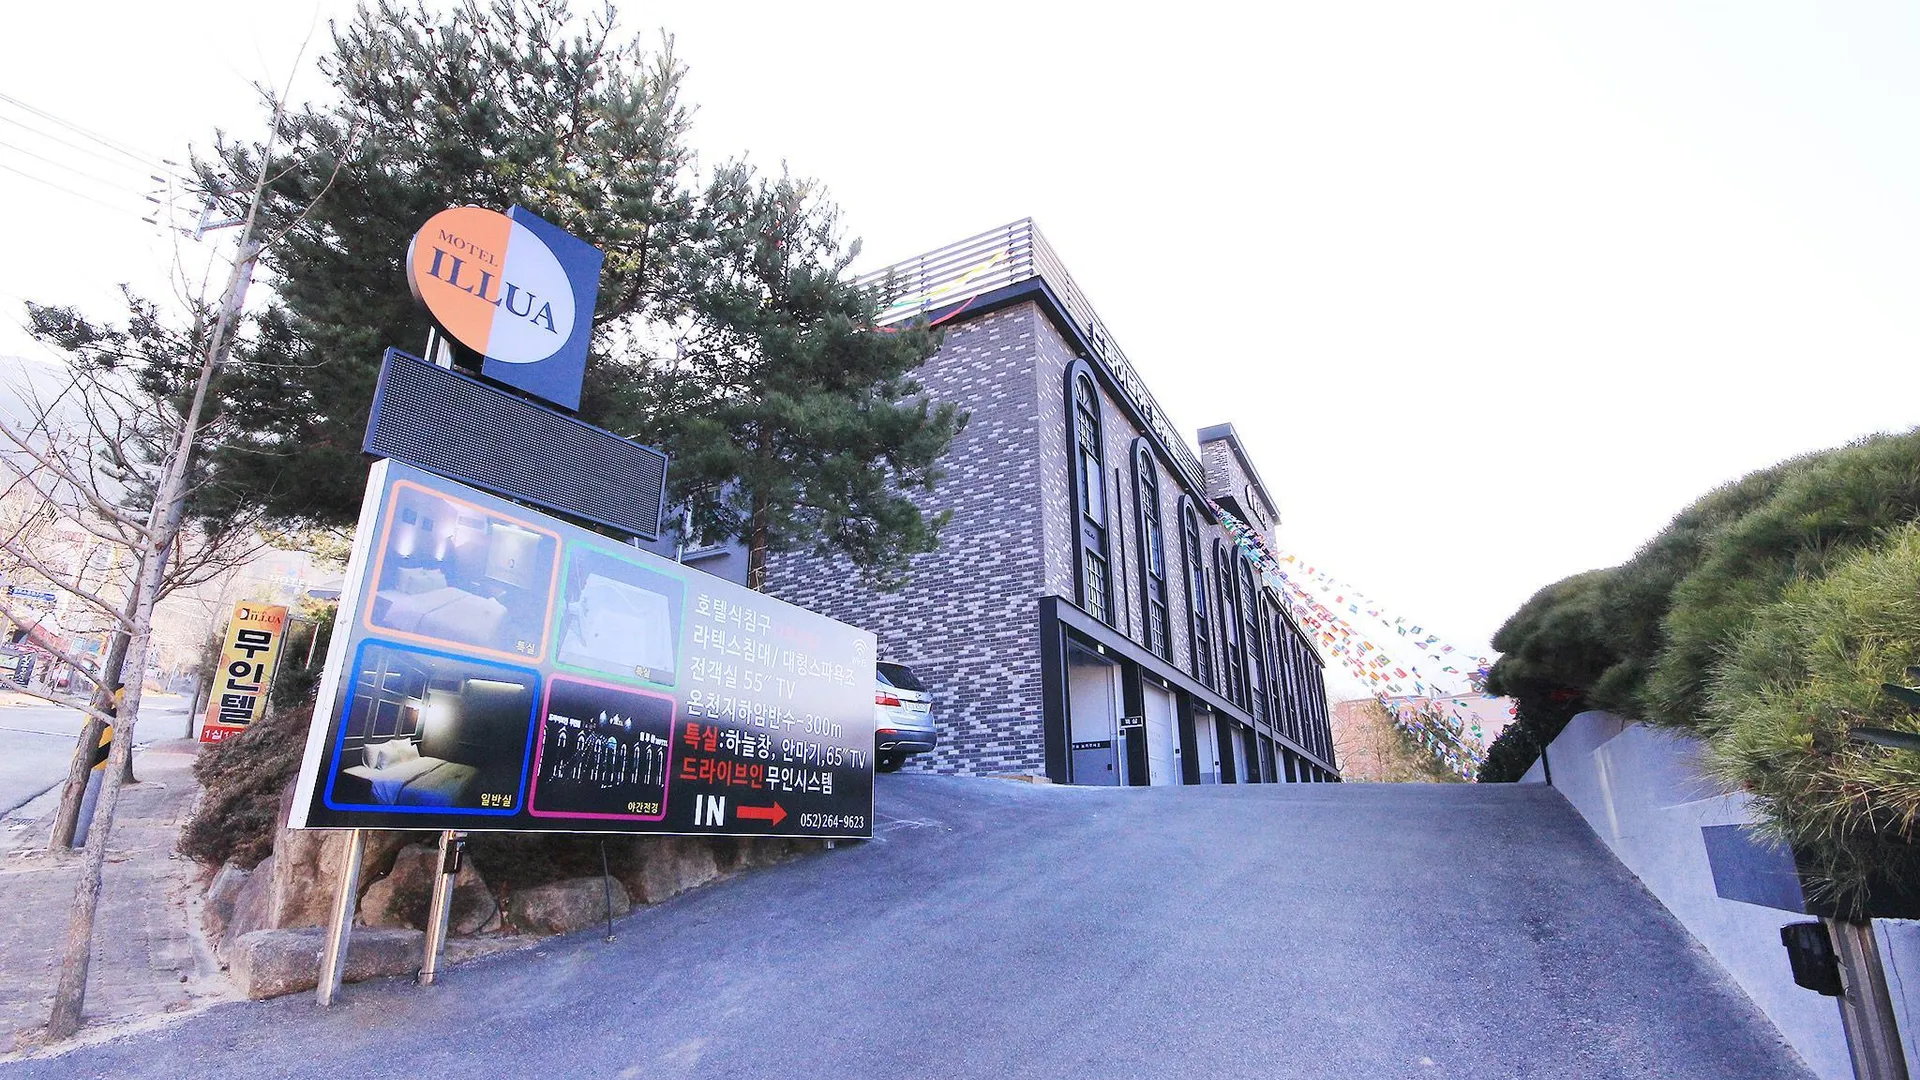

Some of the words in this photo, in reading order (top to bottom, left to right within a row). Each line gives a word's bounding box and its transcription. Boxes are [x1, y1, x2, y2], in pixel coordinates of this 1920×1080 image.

[438, 229, 498, 267] MOTEL
[426, 246, 558, 335] ILLUA
[694, 593, 772, 637] 호텔식침구
[515, 640, 536, 655] 특실
[693, 624, 779, 669] 라텍스침대/
[783, 649, 856, 687] 대형스파욕조
[218, 628, 273, 725] 무인텔
[689, 655, 739, 689] 전객실
[776, 677, 797, 699] TV
[686, 689, 843, 739] 온천지하암반수-300m
[680, 756, 764, 790] 드라이브인
[766, 766, 834, 796] 무인시스템
[480, 793, 513, 808] 일반실
[627, 801, 660, 814] 야간전경
[694, 793, 726, 827] IN
[799, 812, 865, 830] 052)264-9623
